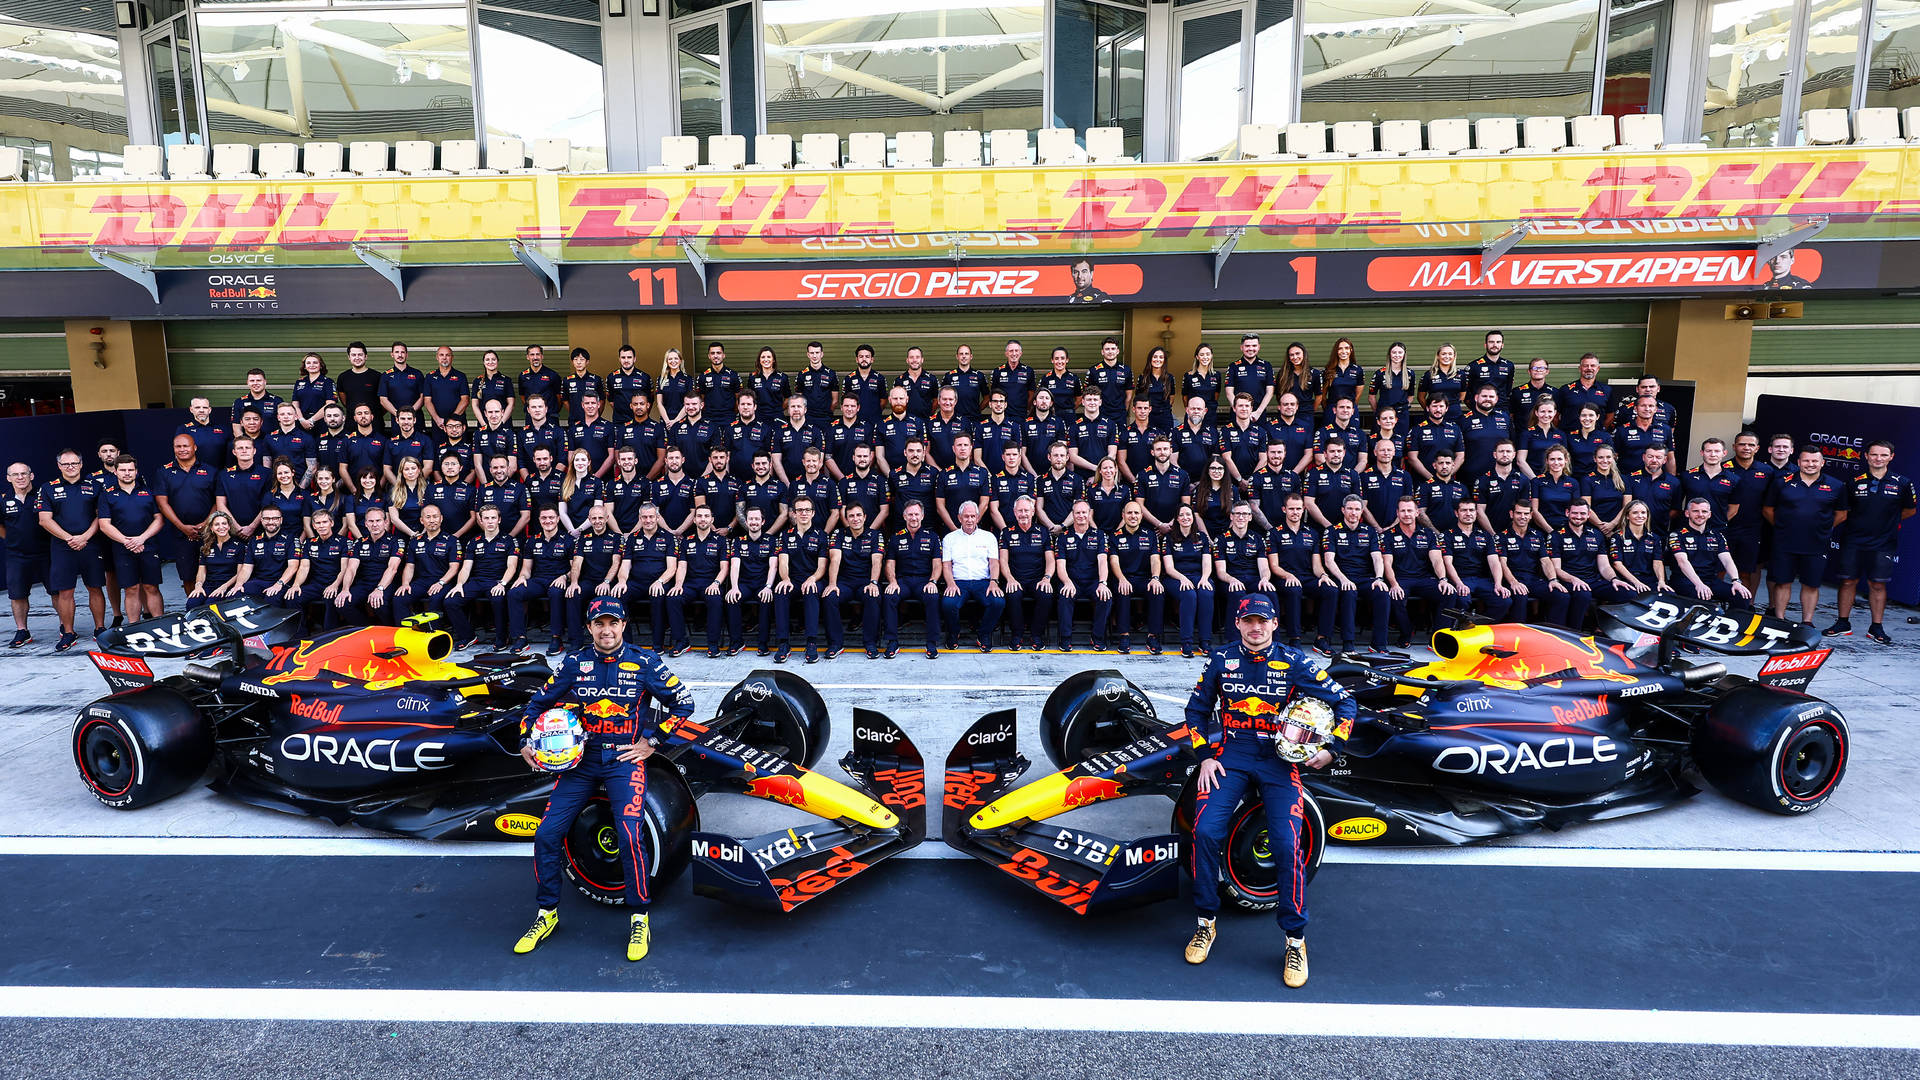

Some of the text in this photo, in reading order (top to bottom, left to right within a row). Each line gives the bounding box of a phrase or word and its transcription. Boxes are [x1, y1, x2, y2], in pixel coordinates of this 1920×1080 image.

[1576, 161, 1883, 223] DHL
[566, 184, 847, 247] DHL
[1057, 174, 1349, 239] DHL
[88, 192, 360, 252] DHL
[1289, 256, 1317, 295] 1
[1409, 255, 1754, 287] MAX VERSTAPPEN
[208, 275, 276, 286] ORACLE
[628, 268, 678, 305] 11
[797, 270, 1040, 298] SERGIO PEREZ
[1810, 432, 1863, 448] ORACLE
[93, 654, 135, 672] Mobil
[1763, 655, 1810, 672] Mobil
[240, 682, 280, 698] HONDA
[577, 687, 637, 698] ORACLE
[1222, 683, 1287, 696] ORACLE
[1620, 683, 1664, 697] HONDA
[603, 719, 633, 734] Bull
[1224, 713, 1252, 729] Red
[856, 727, 894, 743] Claro
[968, 732, 1007, 745] Claro
[281, 733, 456, 772] ORACLE
[1432, 735, 1618, 775] ORACLE
[1343, 824, 1379, 834] RAUCH
[691, 840, 744, 863] Mobil
[1125, 842, 1179, 867] Mobil
